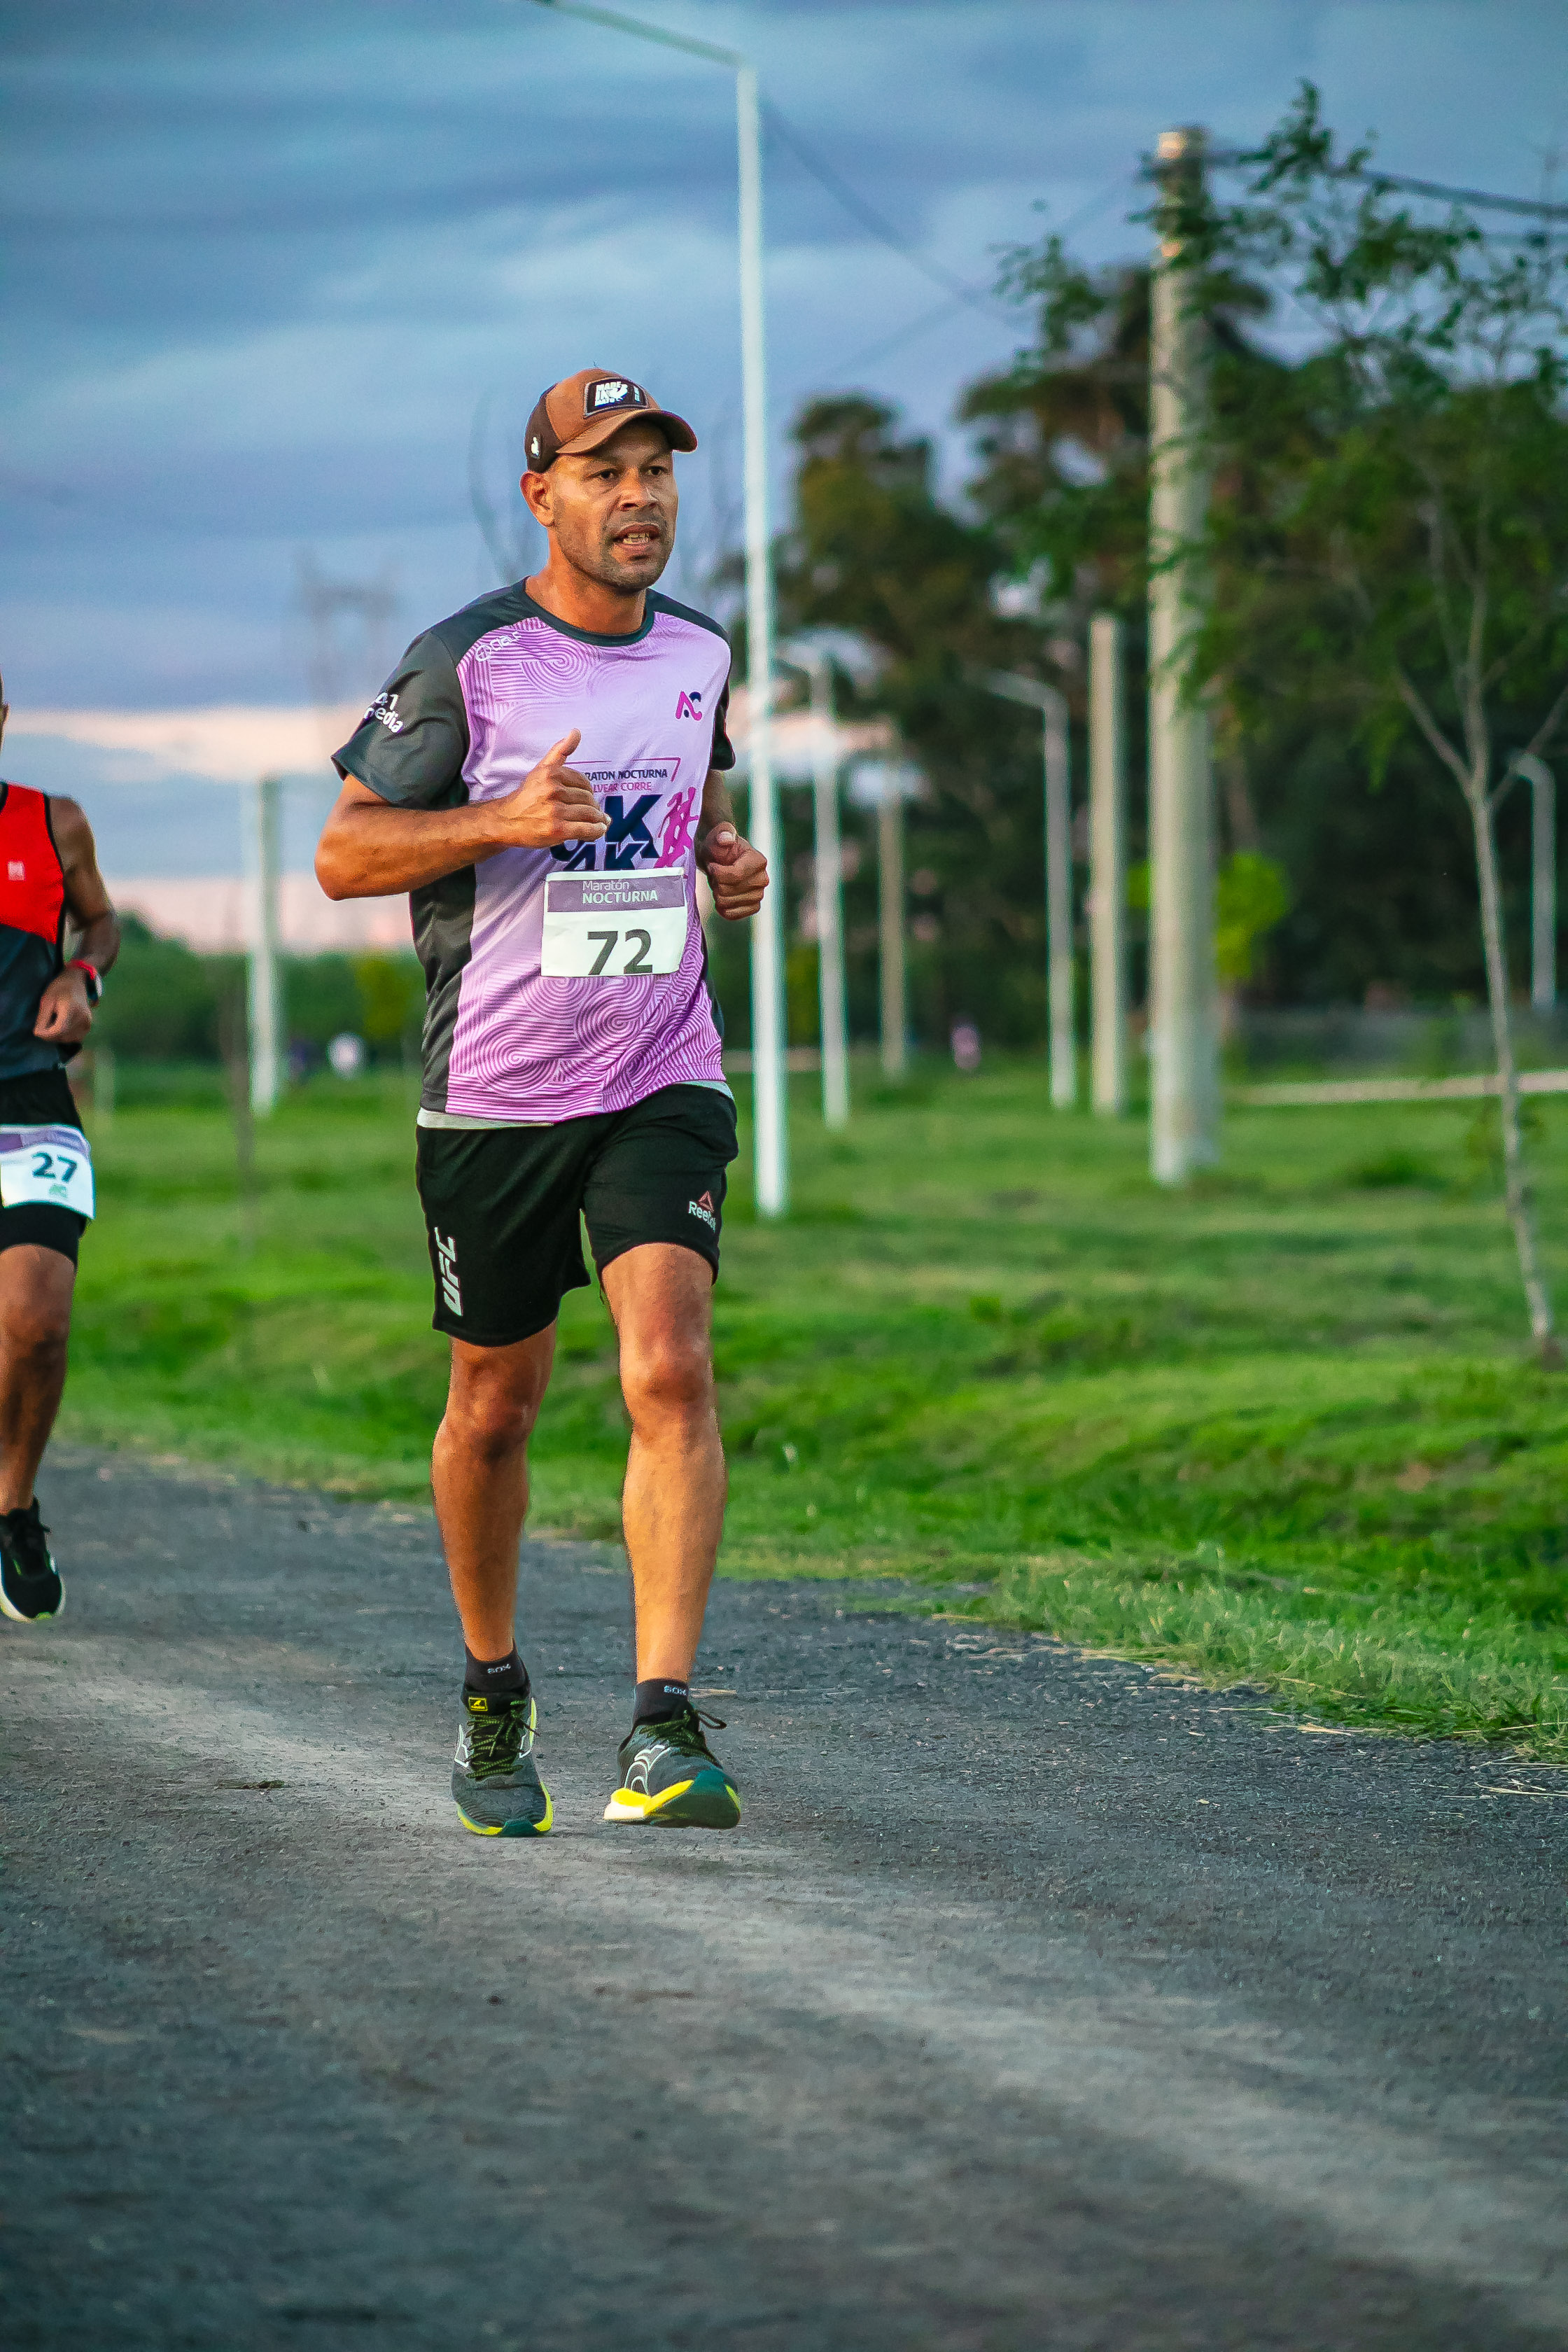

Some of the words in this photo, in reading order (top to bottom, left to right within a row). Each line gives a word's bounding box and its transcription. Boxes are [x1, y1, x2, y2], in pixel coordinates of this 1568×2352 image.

[584, 771, 616, 781] RATON
[617, 769, 668, 780] NOCTURNA
[592, 783, 619, 793] LVEAR
[620, 781, 652, 792] CORRE
[582, 879, 631, 891] Maratón
[582, 890, 659, 904] NOCTURNA
[587, 928, 653, 976] 72
[31, 1152, 78, 1183] 27
